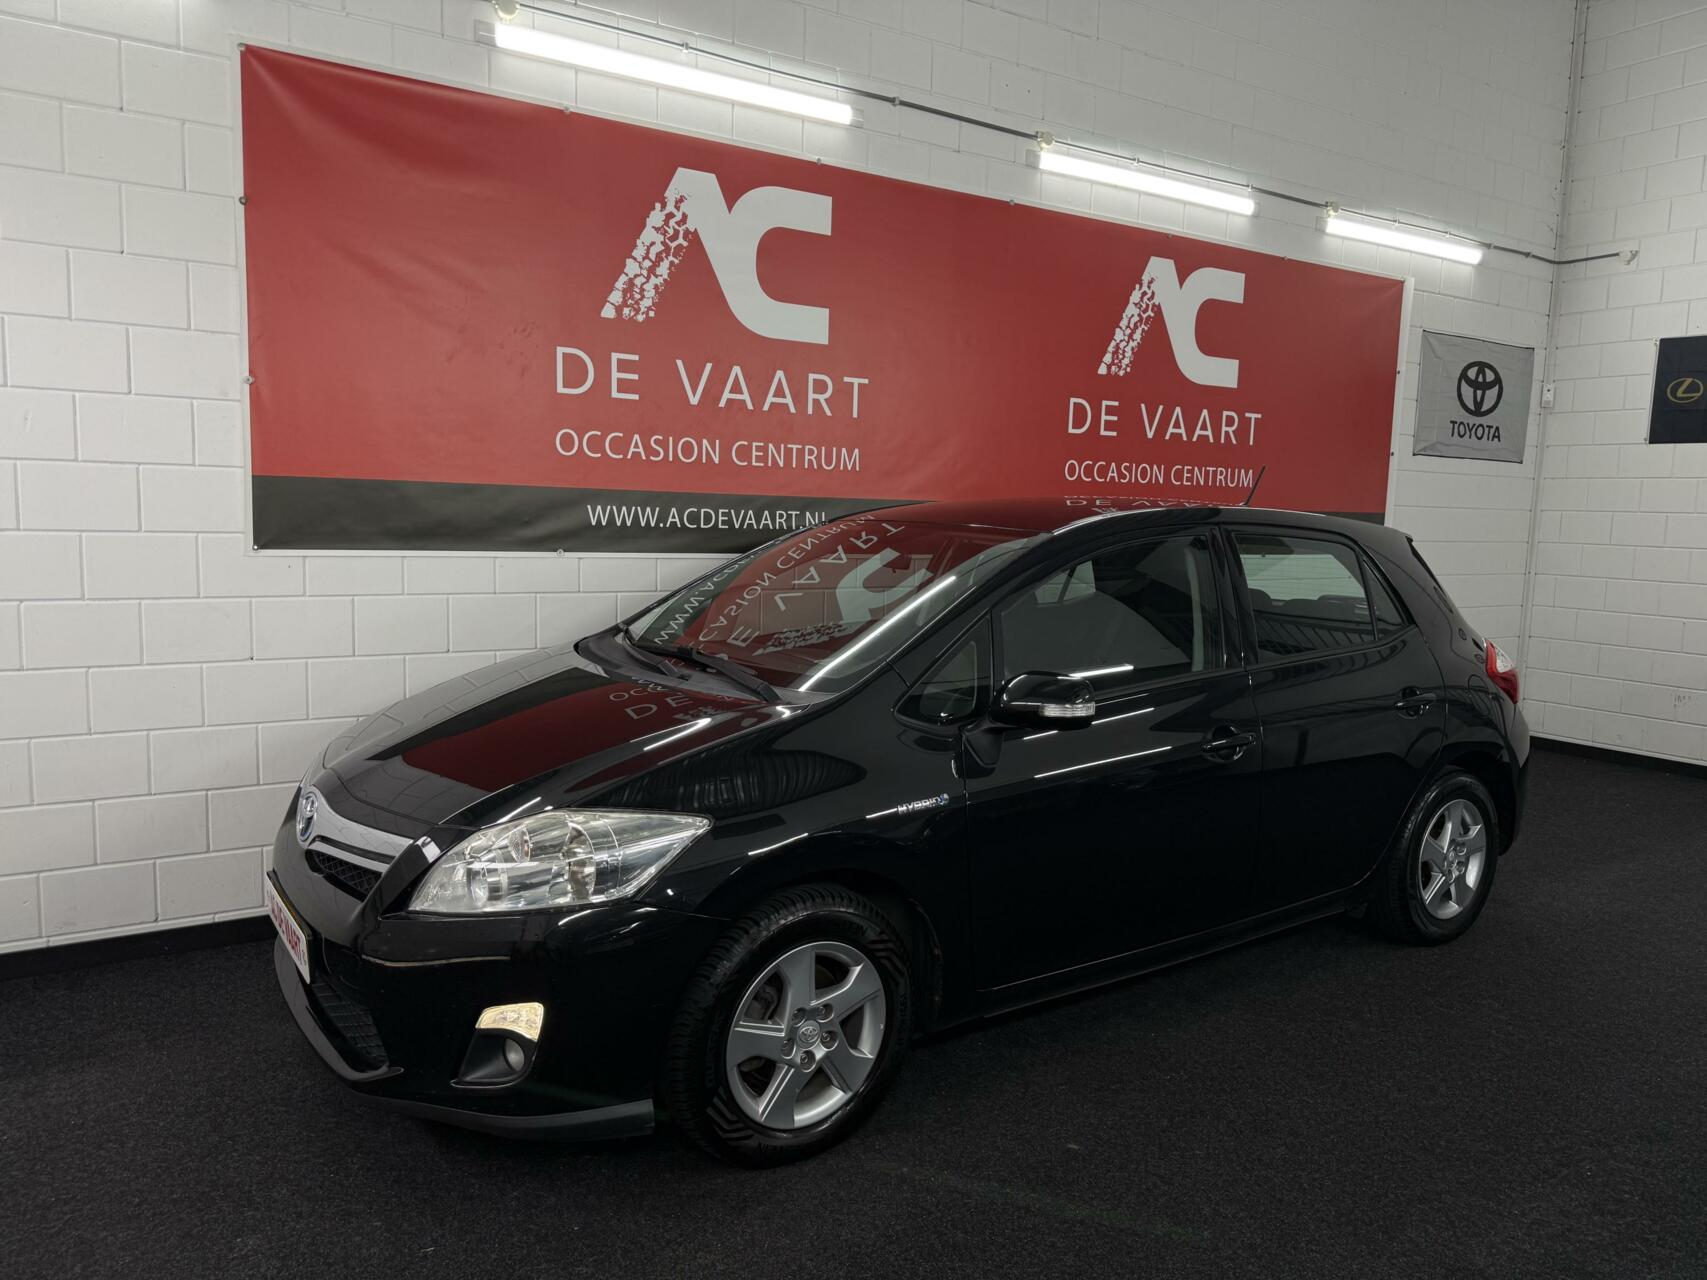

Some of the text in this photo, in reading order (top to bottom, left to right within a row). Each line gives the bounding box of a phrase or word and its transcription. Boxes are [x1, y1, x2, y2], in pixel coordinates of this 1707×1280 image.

[600, 166, 833, 345] AC
[1097, 256, 1246, 389] AC
[556, 346, 869, 418] DE VAART
[1067, 397, 1262, 446] DE VAART
[1449, 420, 1501, 443] TOYOTA
[555, 428, 861, 472] OCCASION CENTRUM
[1064, 459, 1254, 488] OCCASION CENTRUM
